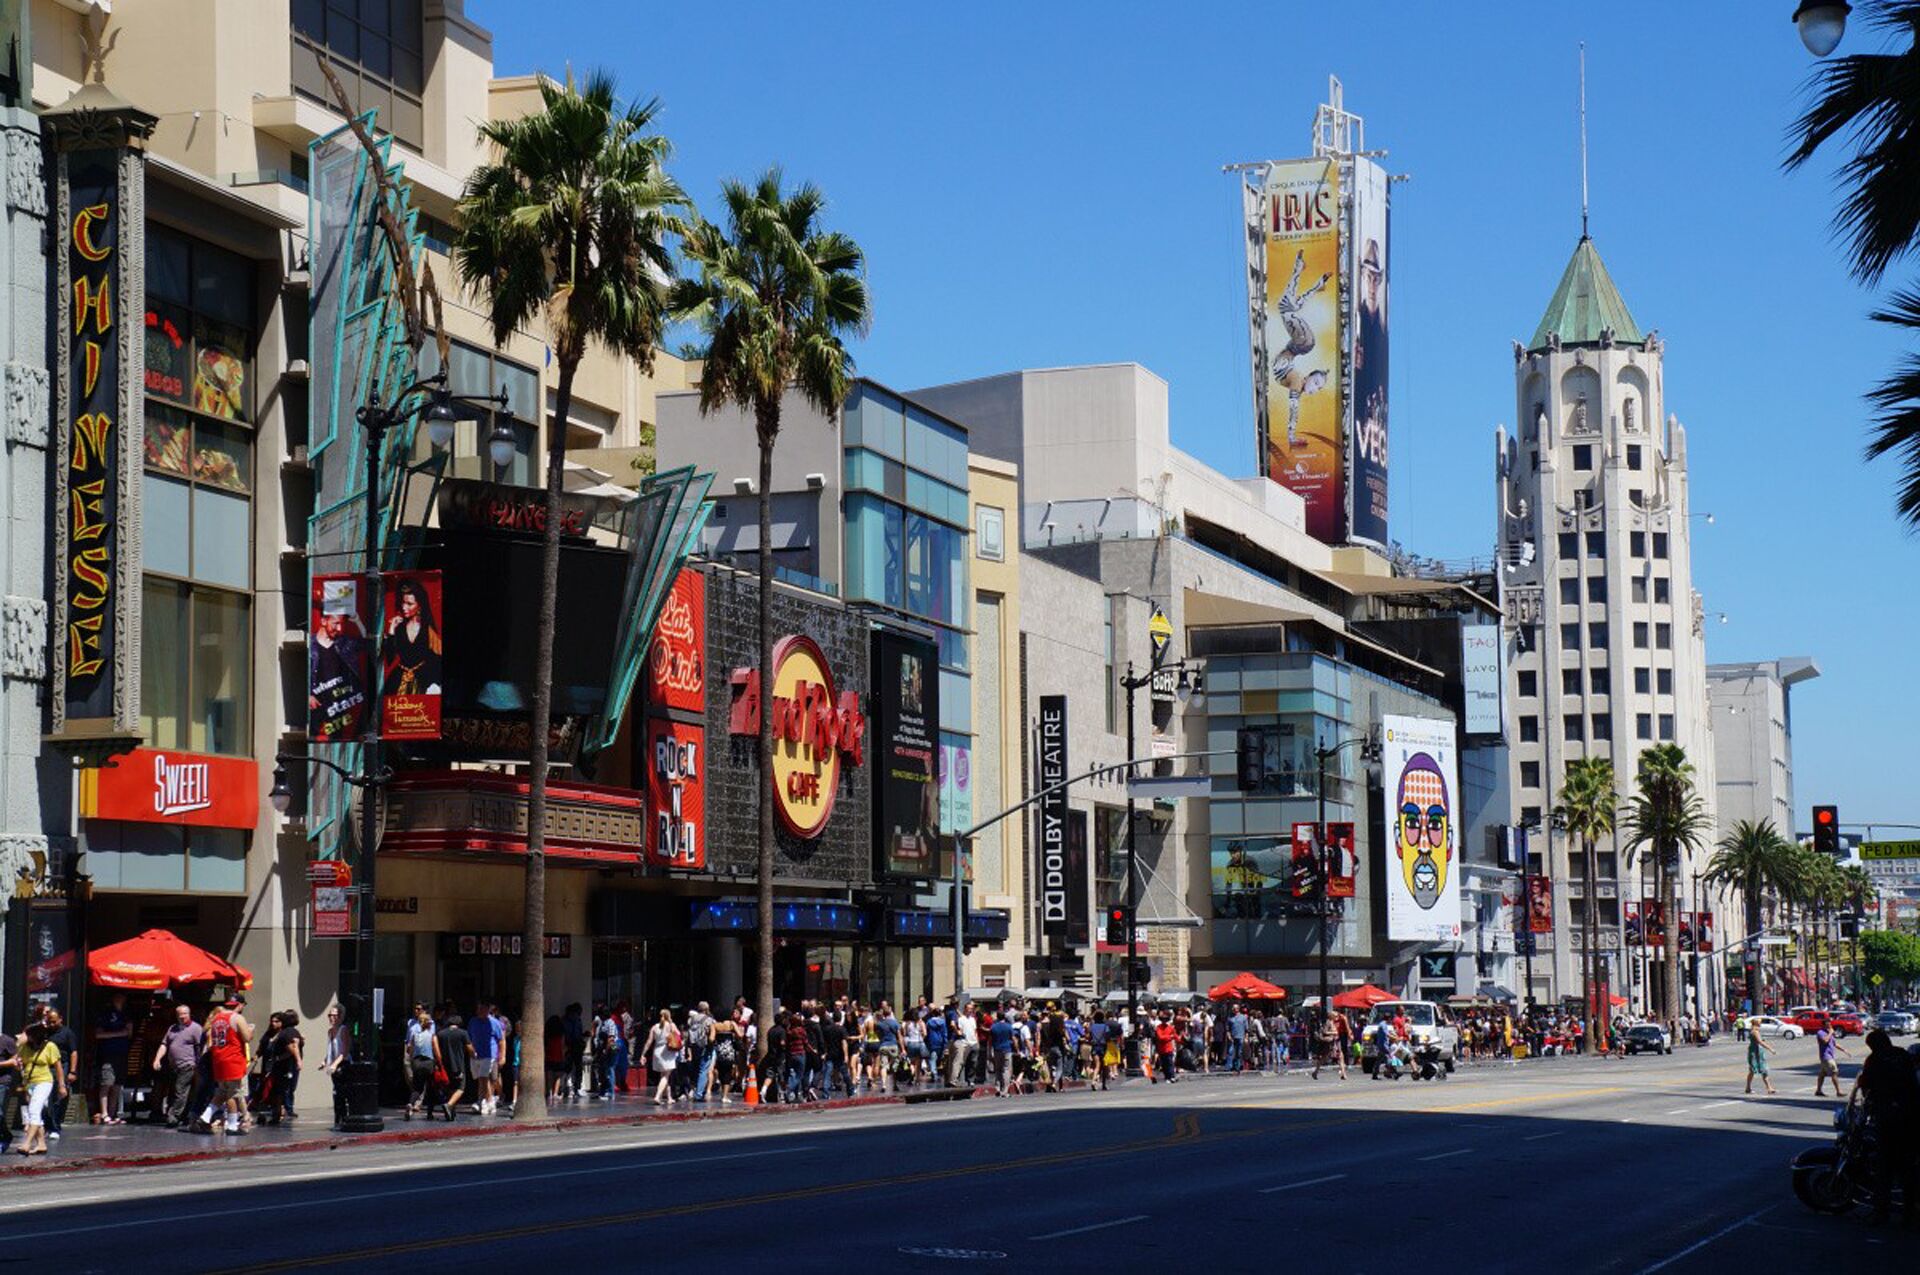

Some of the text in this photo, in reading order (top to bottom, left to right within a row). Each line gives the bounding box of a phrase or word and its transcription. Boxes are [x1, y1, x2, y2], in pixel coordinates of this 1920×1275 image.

[1271, 191, 1332, 233] IRIS
[71, 203, 113, 677] CHINESE
[1466, 664, 1497, 673] LAVO
[327, 692, 364, 717] stars
[728, 667, 806, 743] Hrd
[656, 735, 697, 780] ROCK
[671, 783, 682, 817] N
[786, 771, 821, 802] CAFE
[1044, 709, 1064, 887] DOLBY THEATRE
[657, 811, 696, 864] ROLL
[1864, 844, 1893, 857] PED
